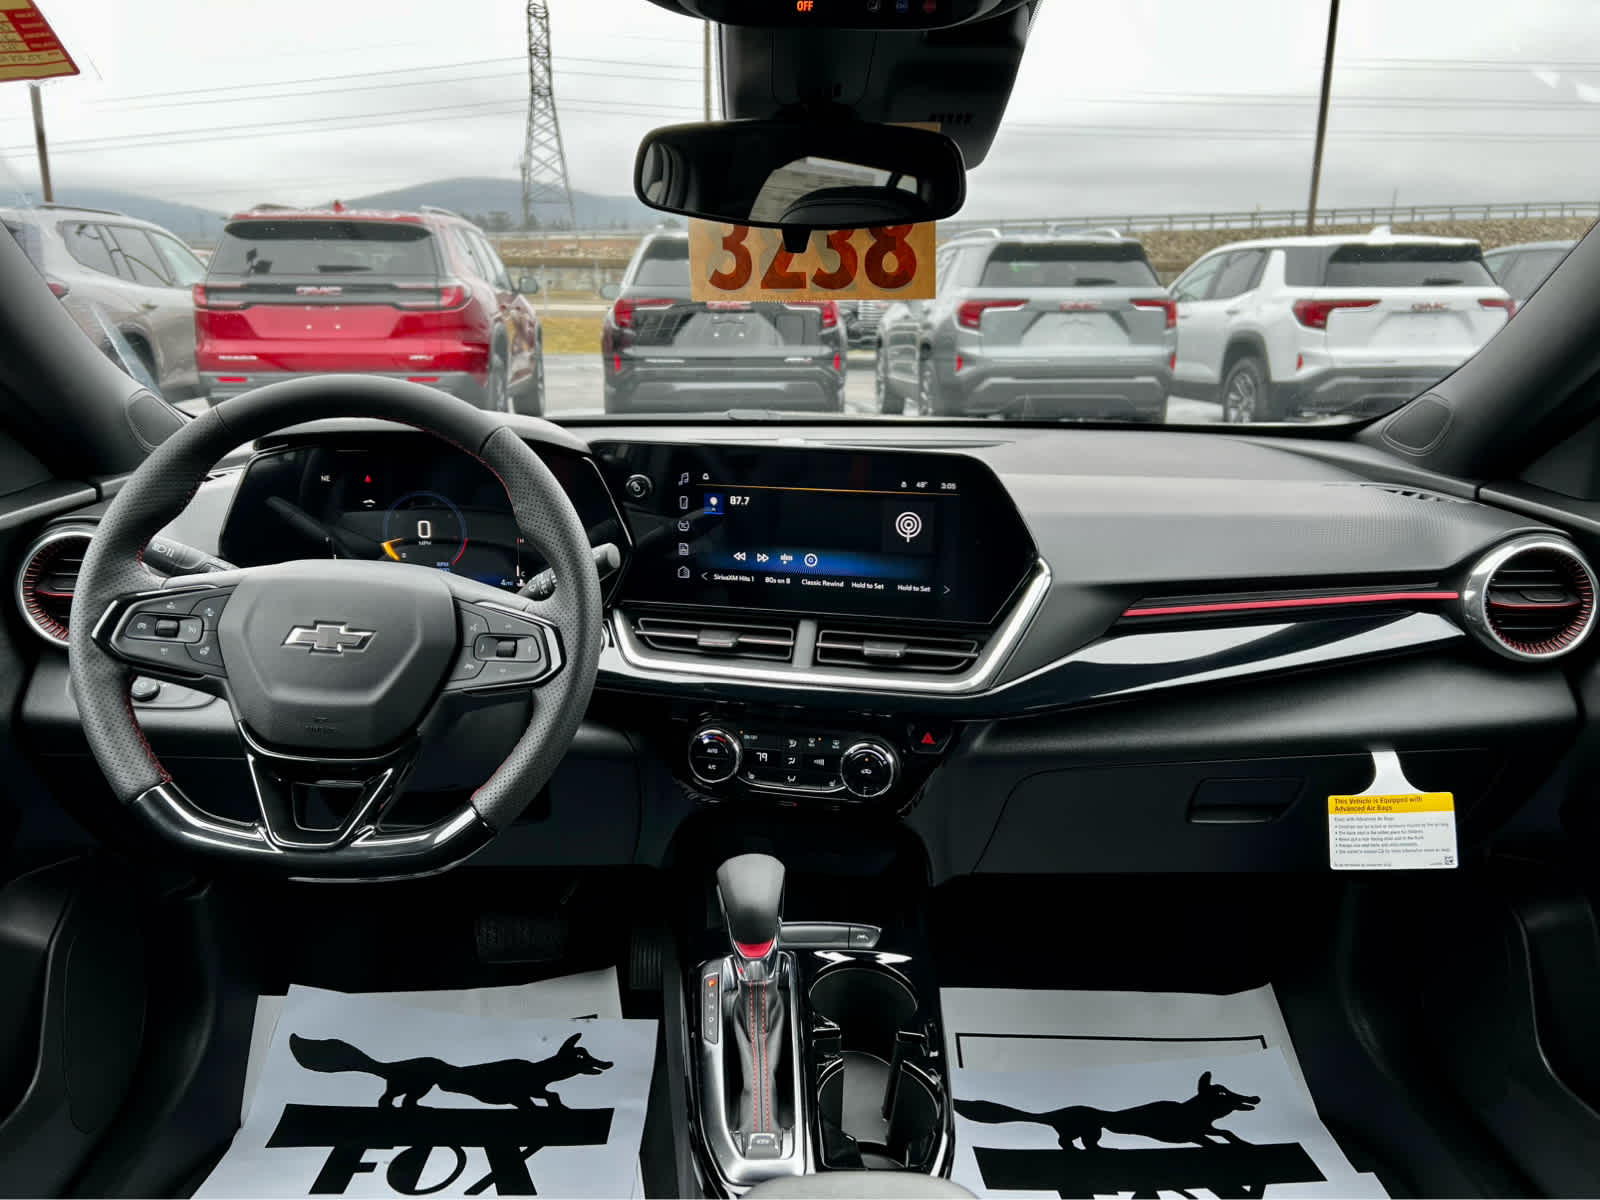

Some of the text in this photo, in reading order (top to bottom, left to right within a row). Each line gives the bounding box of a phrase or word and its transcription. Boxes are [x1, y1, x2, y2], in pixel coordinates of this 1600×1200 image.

[796, 0, 814, 12] OFF
[708, 224, 918, 291] 3238
[729, 495, 750, 505] 87.7
[417, 520, 431, 539] 0
[801, 578, 844, 588] Classic Rewind
[851, 581, 866, 589] Hold
[874, 582, 884, 590] Set
[897, 584, 912, 592] Hold
[920, 585, 931, 593] Set
[755, 751, 768, 762] 79
[1380, 796, 1408, 805] Equipped
[1377, 804, 1393, 812] Bags
[308, 1146, 545, 1196] FOX
